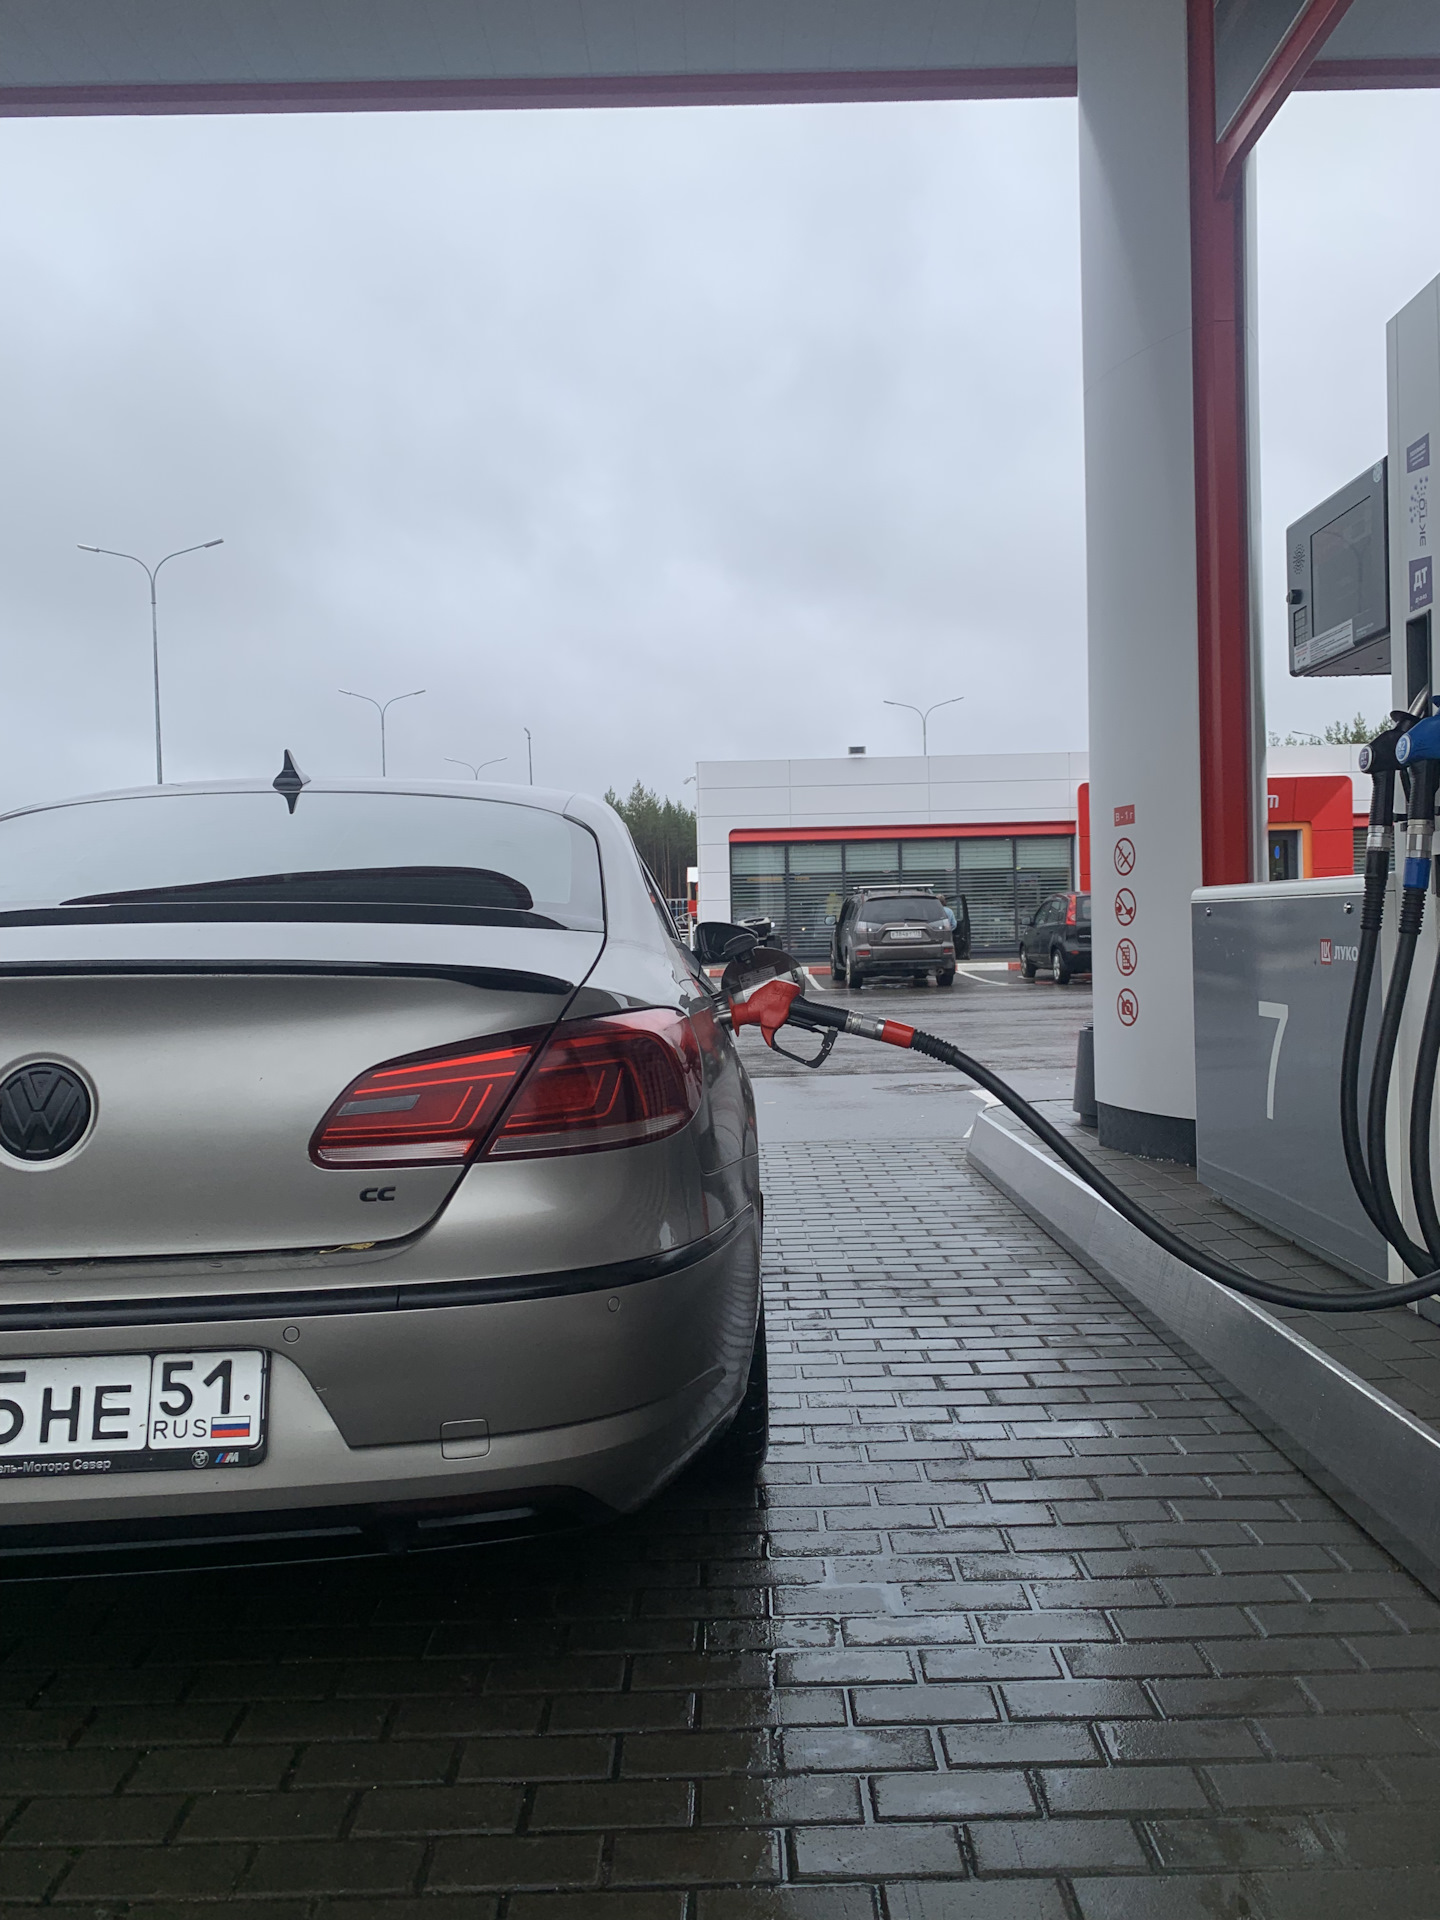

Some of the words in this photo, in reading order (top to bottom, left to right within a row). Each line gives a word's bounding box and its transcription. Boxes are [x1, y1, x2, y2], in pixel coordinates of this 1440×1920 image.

[1413, 566, 1428, 592] ДТ
[1258, 1000, 1289, 1120] 7
[159, 1360, 233, 1416] 51
[153, 1419, 207, 1439] RUS
[72, 1458, 111, 1471] Север
